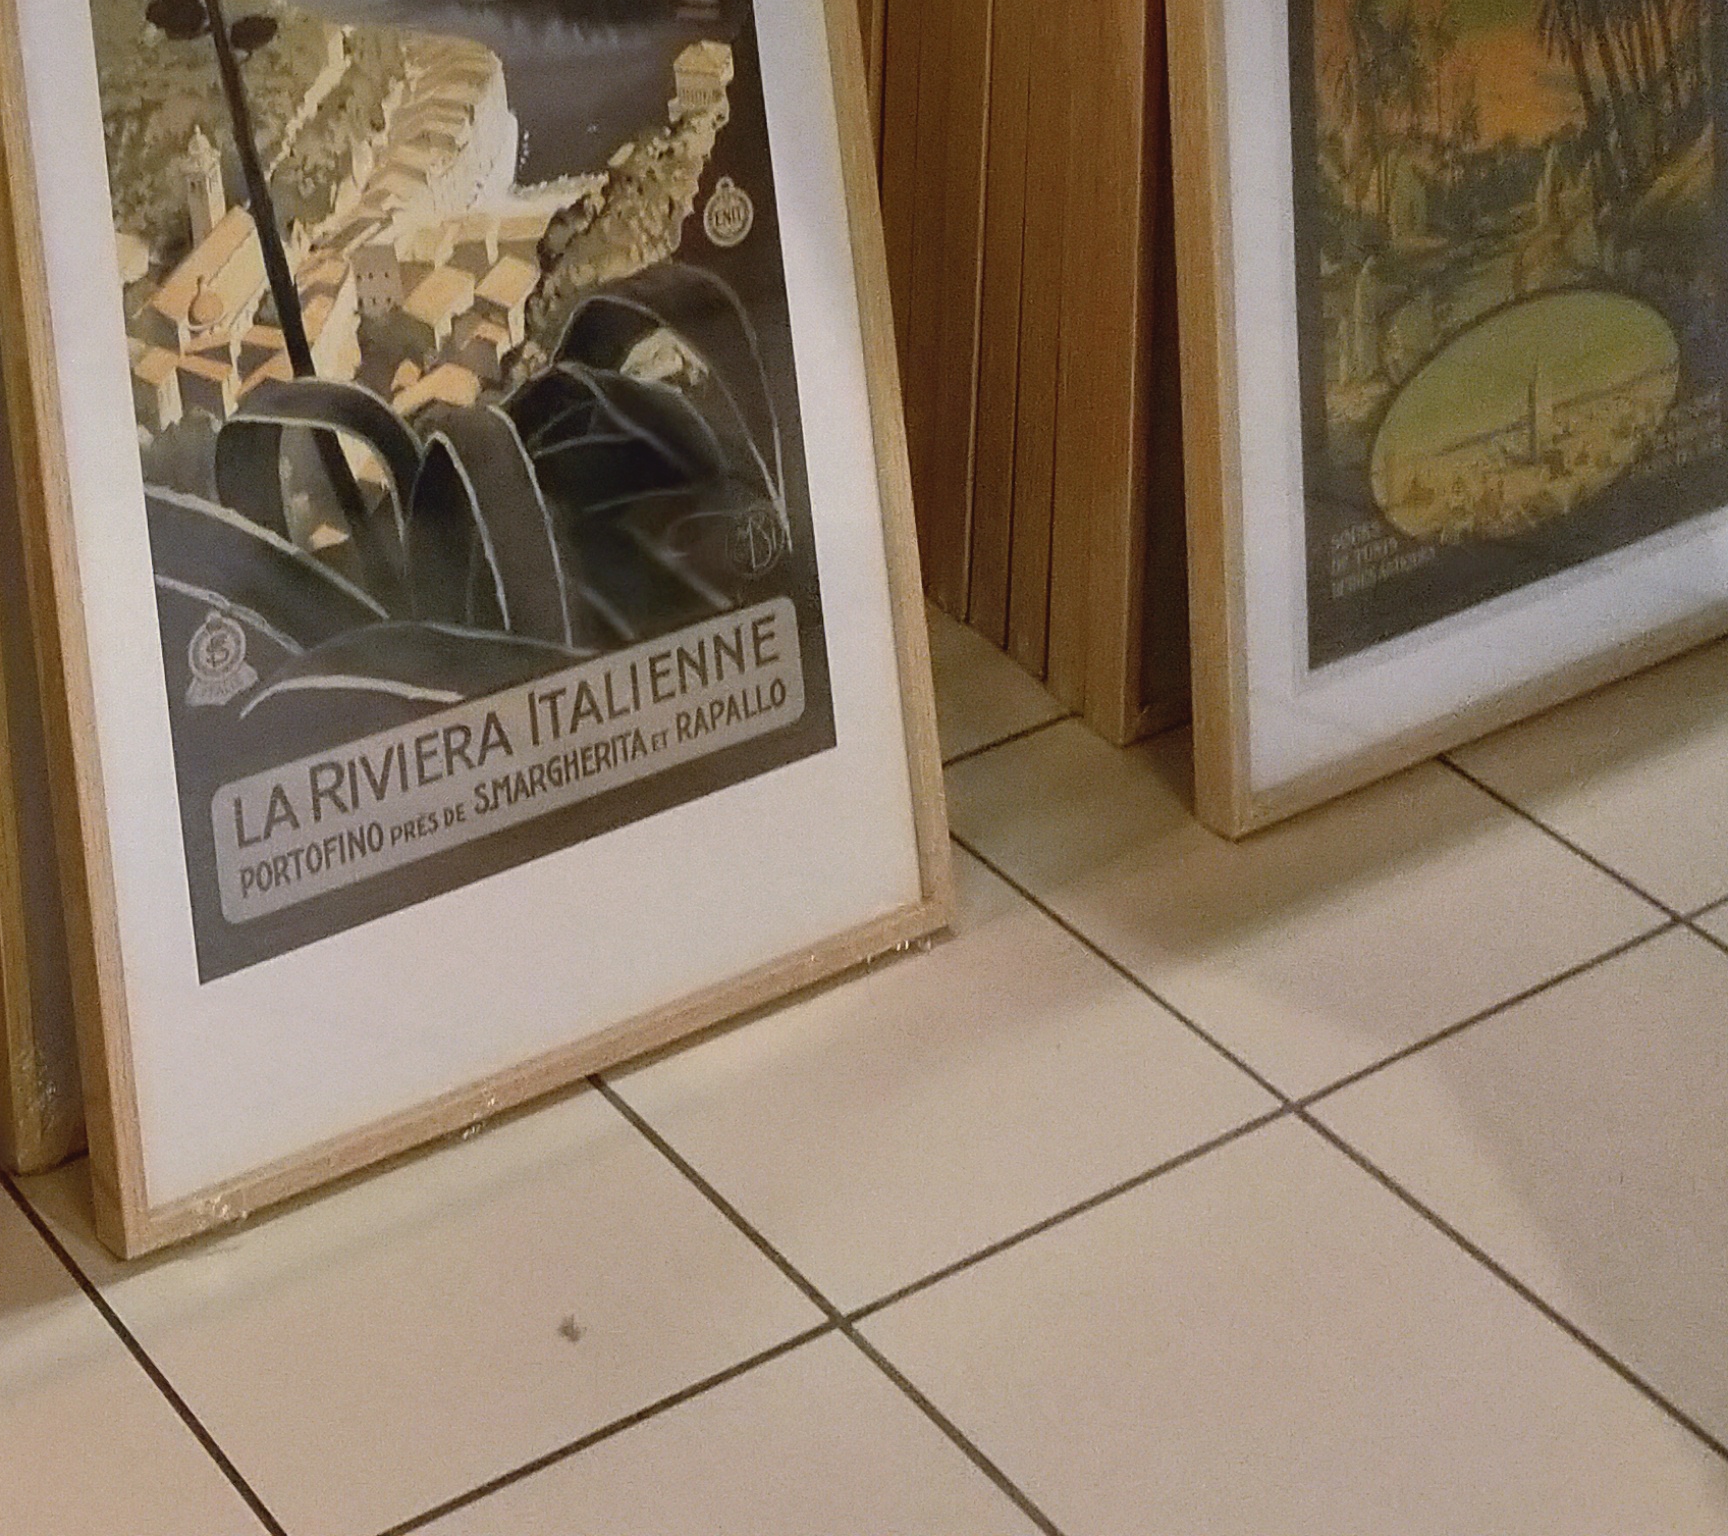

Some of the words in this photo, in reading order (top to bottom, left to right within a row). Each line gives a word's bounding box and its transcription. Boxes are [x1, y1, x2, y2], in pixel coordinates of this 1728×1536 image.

[233, 783, 301, 849] LA
[308, 710, 514, 824] RIVIERA
[526, 615, 780, 748] ITALIENNE
[239, 820, 384, 899] PORTOFINO
[443, 802, 467, 827] DE
[650, 732, 669, 753] ET
[674, 677, 787, 745] RAPALLO
